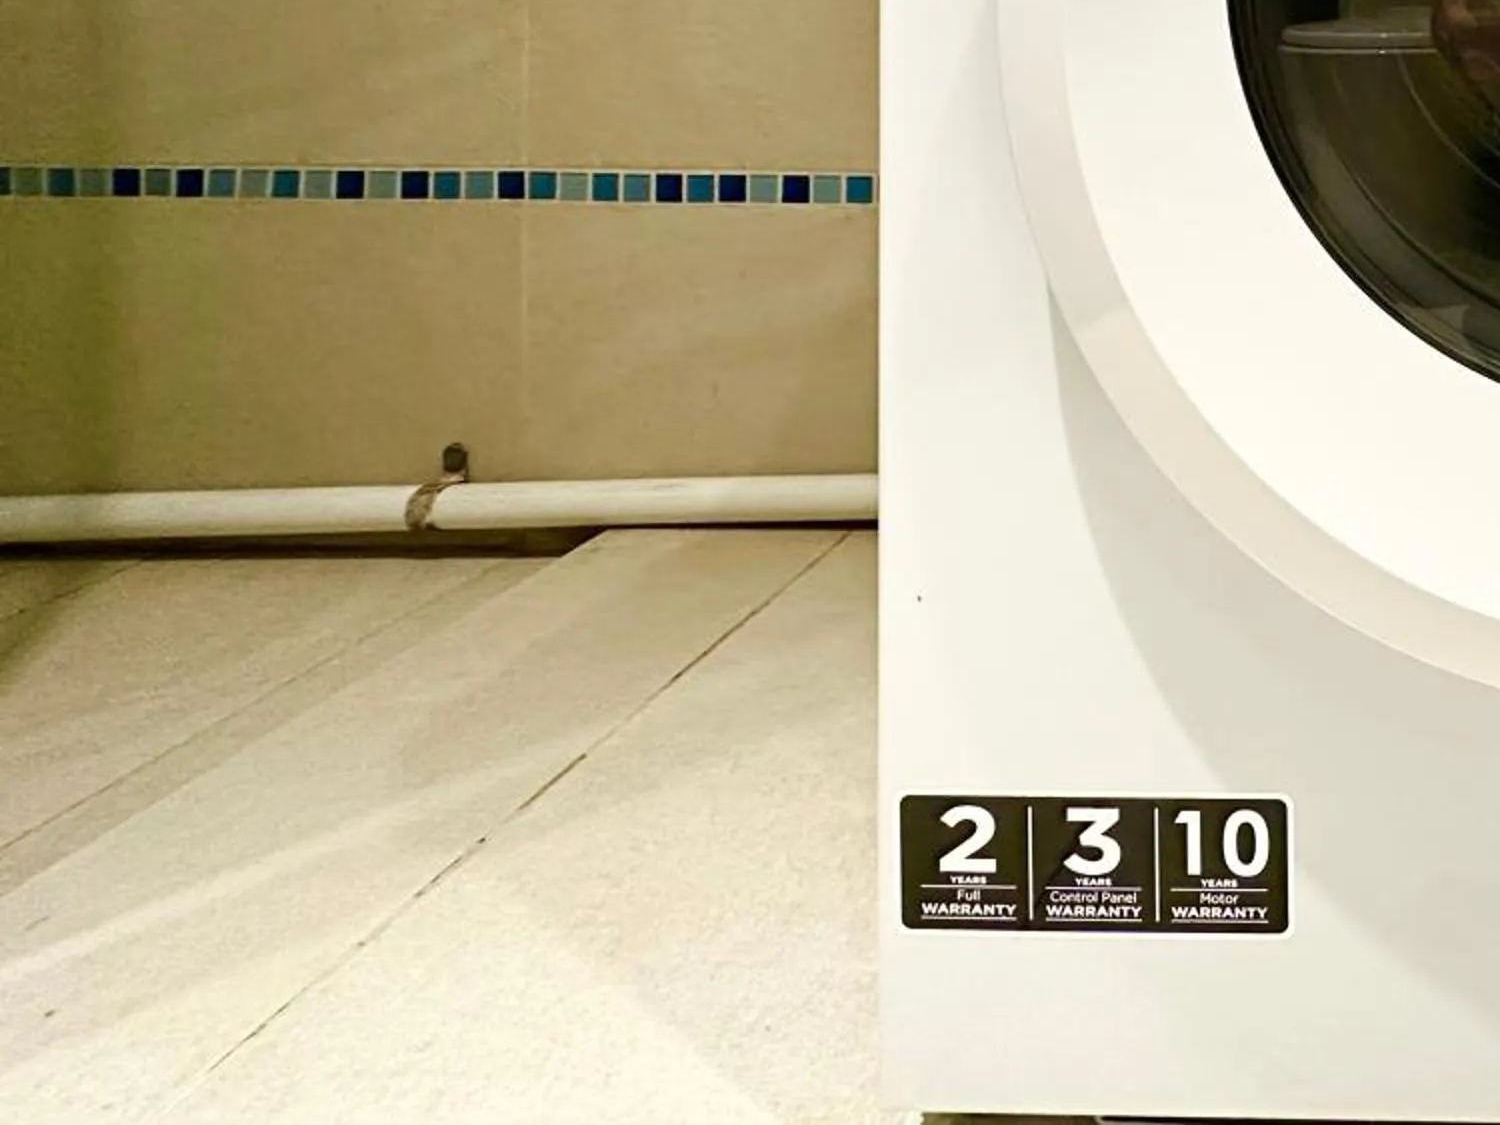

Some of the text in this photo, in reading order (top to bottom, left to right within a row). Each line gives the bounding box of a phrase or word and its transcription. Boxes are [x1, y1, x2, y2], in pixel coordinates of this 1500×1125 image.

[938, 804, 997, 874] 2
[1063, 806, 1122, 876] 3
[1174, 808, 1270, 877] 10
[949, 876, 988, 885] YEARS
[1075, 878, 1113, 887] YEARS
[1200, 879, 1238, 888] YEARS
[956, 889, 981, 901] Full
[1049, 891, 1138, 904] Control Panel
[1199, 893, 1239, 905] Motor
[921, 903, 1017, 916] WARRANTY
[1045, 905, 1142, 918] WARRANTY
[1171, 907, 1269, 919] WARRANTY
